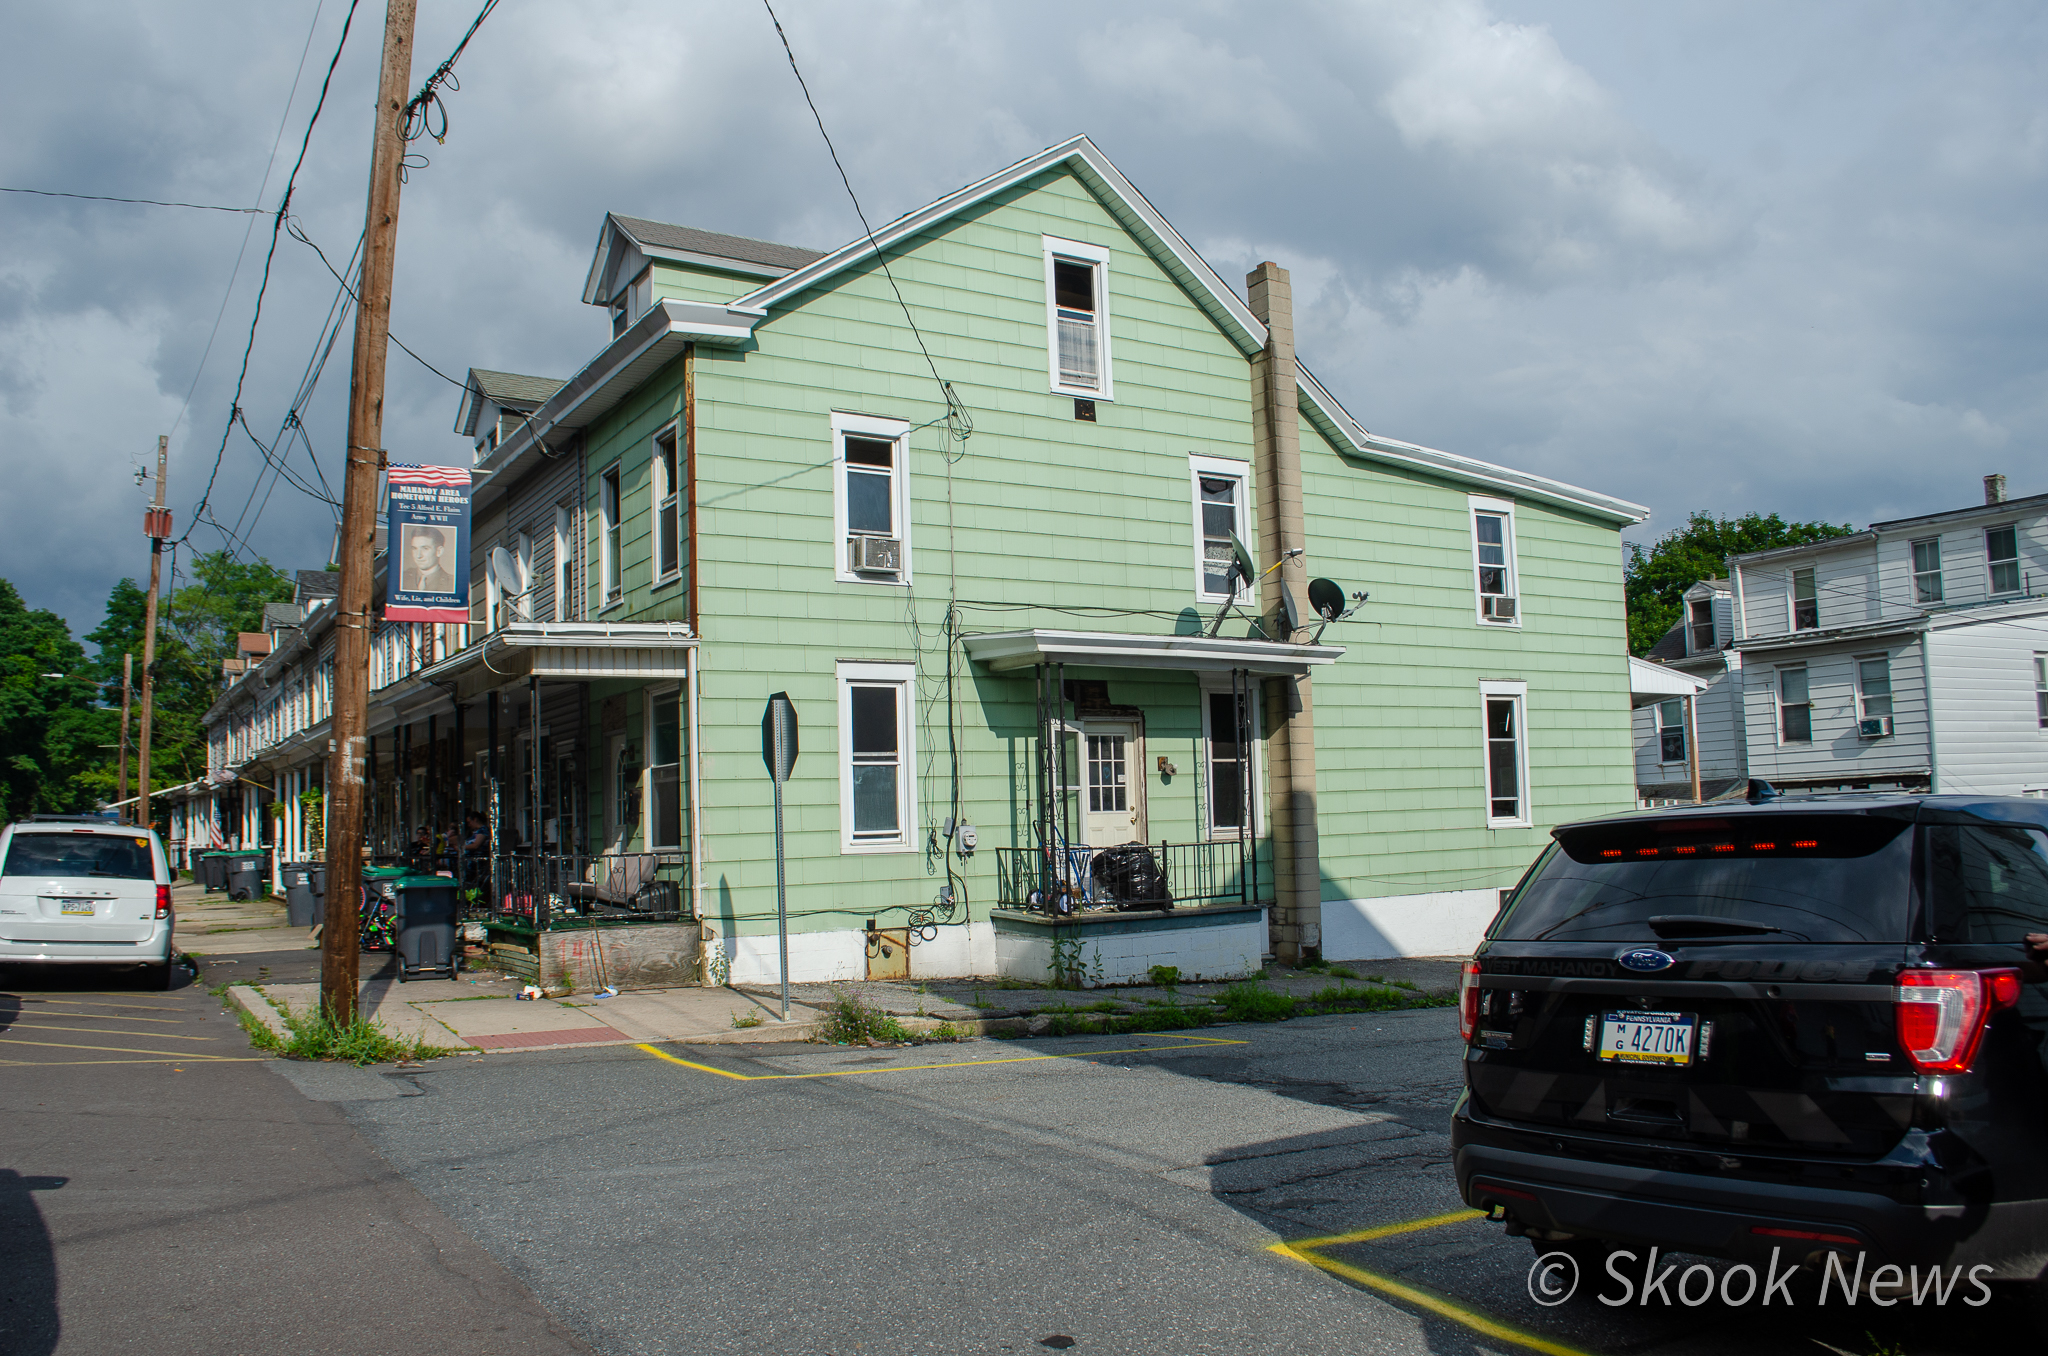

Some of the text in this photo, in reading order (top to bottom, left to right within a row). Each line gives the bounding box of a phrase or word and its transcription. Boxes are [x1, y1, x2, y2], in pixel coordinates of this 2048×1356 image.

[399, 486, 461, 497] MAHANOY AREA
[391, 492, 469, 504] HOMETOWN HEROES
[411, 514, 427, 522] Army
[394, 594, 411, 602] Wife,
[1629, 952, 1659, 967] Ford
[1481, 957, 1619, 977] WEST MAHANOY
[1684, 960, 1877, 982] POLICE
[1626, 1015, 1672, 1024] PENNSYLVANIA
[1617, 1024, 1626, 1034] M
[1631, 1025, 1687, 1053] 4270K
[1615, 1040, 1624, 1050] G
